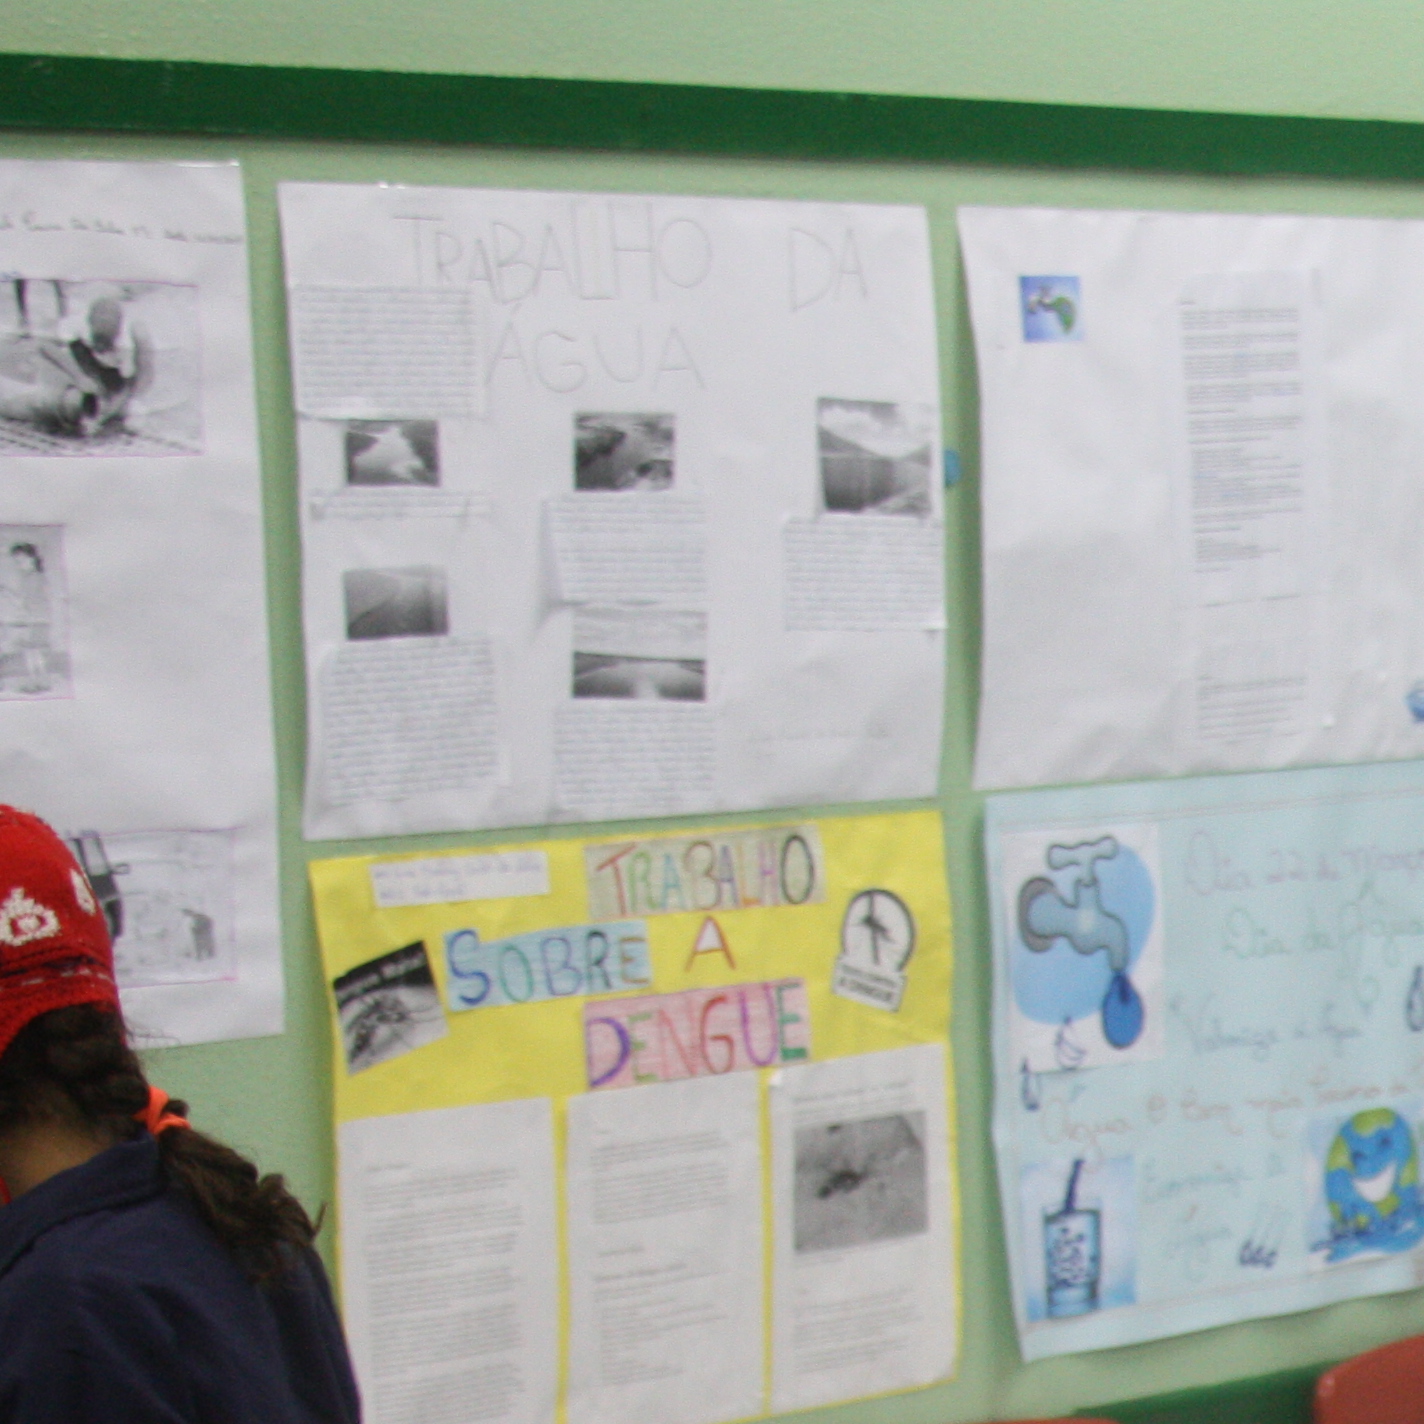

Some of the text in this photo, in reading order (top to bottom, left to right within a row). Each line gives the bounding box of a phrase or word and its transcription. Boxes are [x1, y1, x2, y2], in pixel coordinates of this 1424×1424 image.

[392, 199, 869, 313] TRABALHO DA
[596, 833, 815, 918] TRABALHO
[446, 928, 652, 1007] SOBRE
[683, 914, 737, 971] A
[586, 981, 808, 1088] DENGUE
